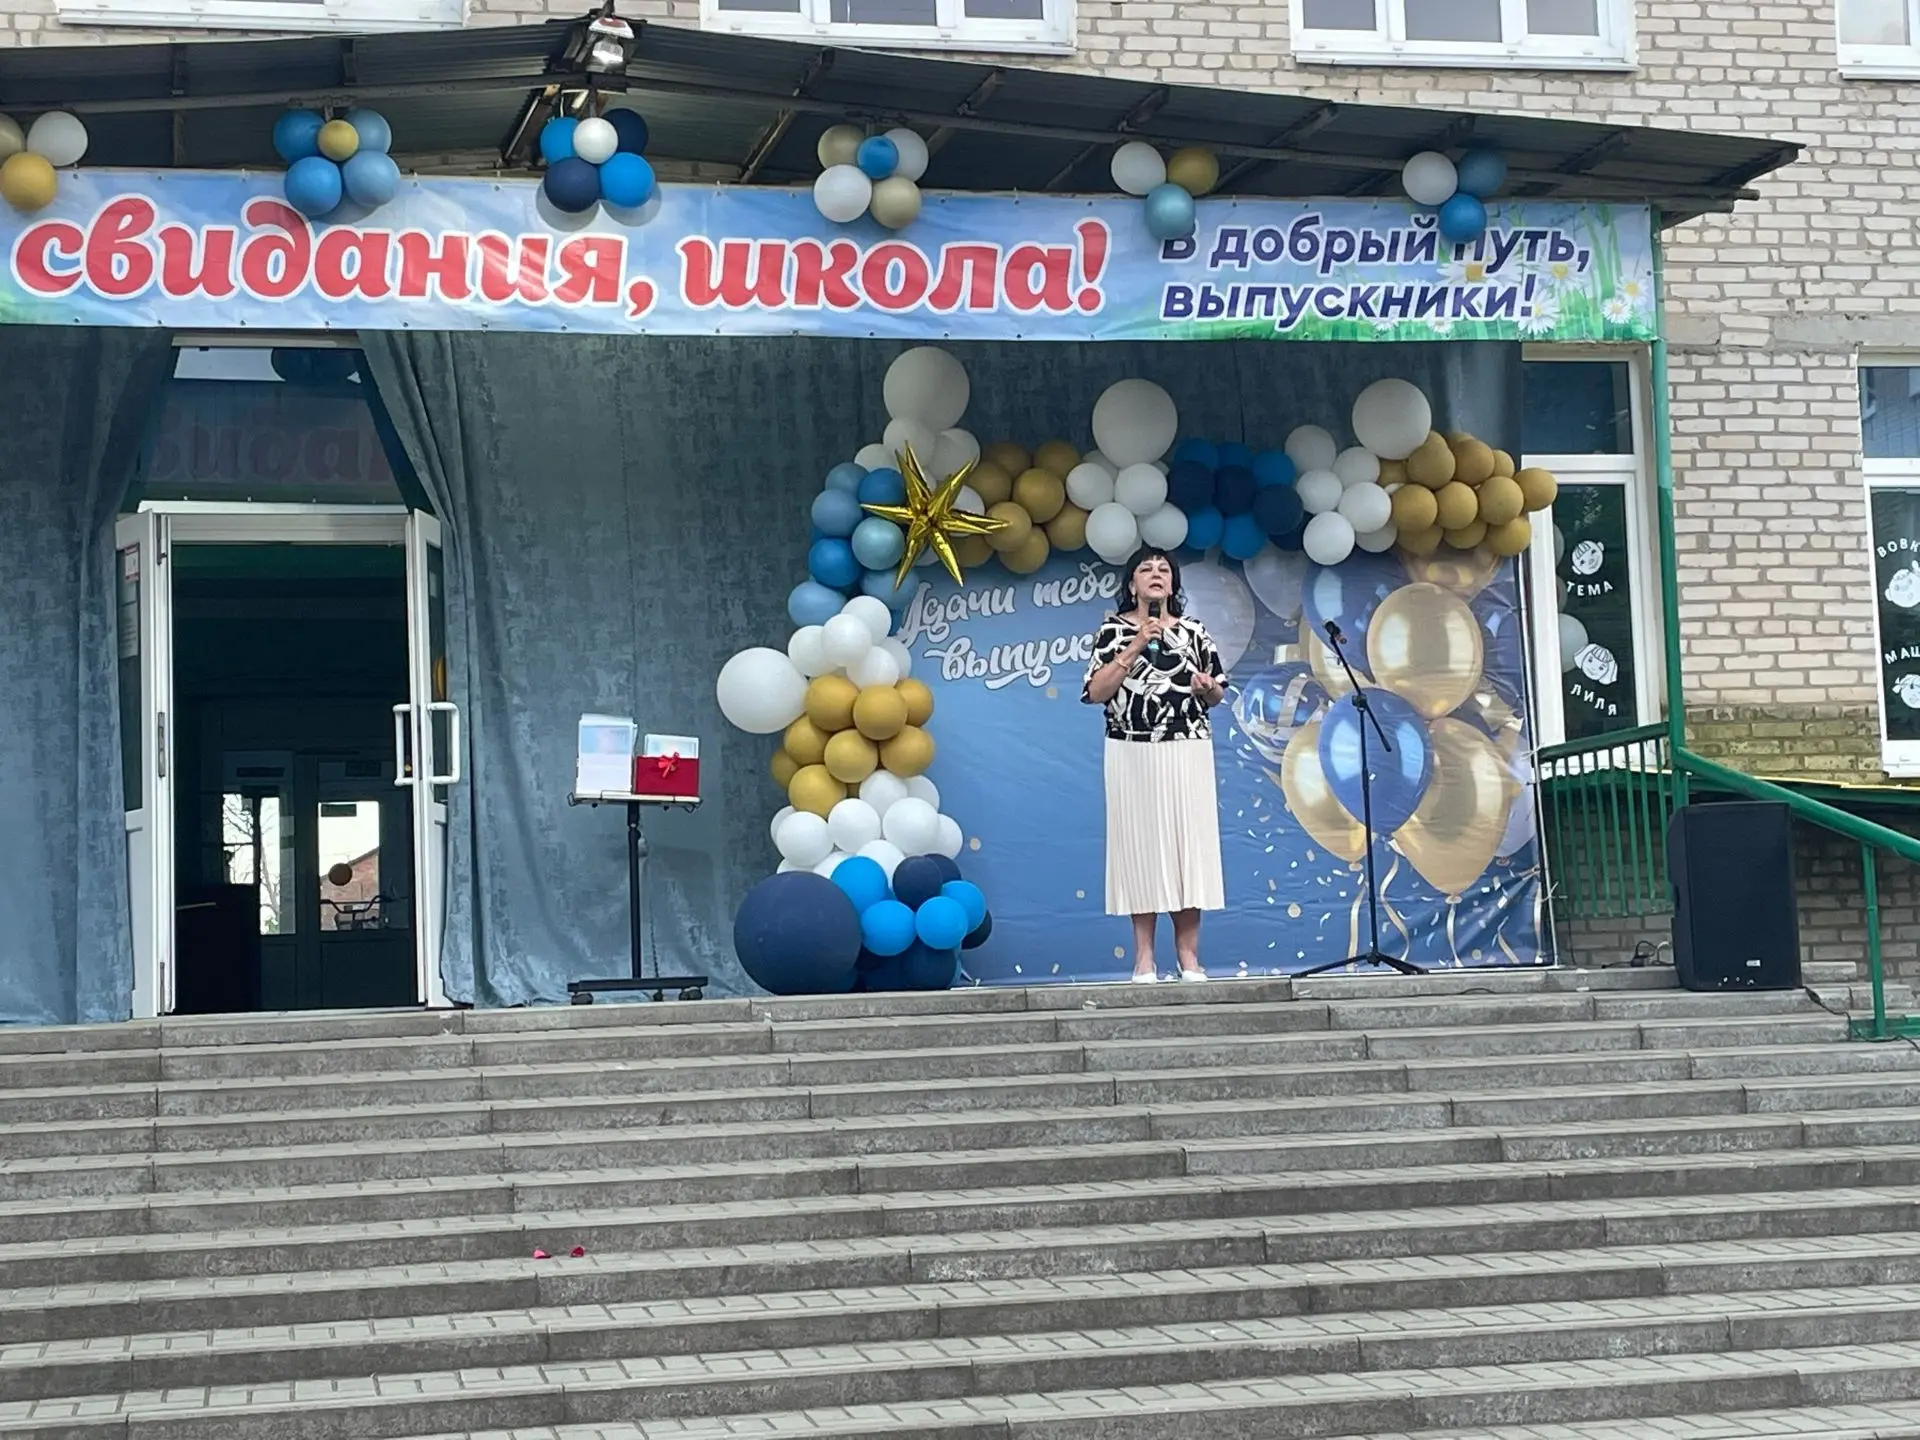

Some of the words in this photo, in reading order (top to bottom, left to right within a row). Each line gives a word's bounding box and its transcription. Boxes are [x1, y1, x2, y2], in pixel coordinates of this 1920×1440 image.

[13, 195, 657, 318] свидания,
[678, 219, 1109, 313] школа!
[1209, 214, 1438, 273] добрый
[1162, 273, 1537, 327] выпускники!
[1566, 580, 1614, 597] ТЕМА
[1569, 683, 1618, 716] ЛИЛЯ
